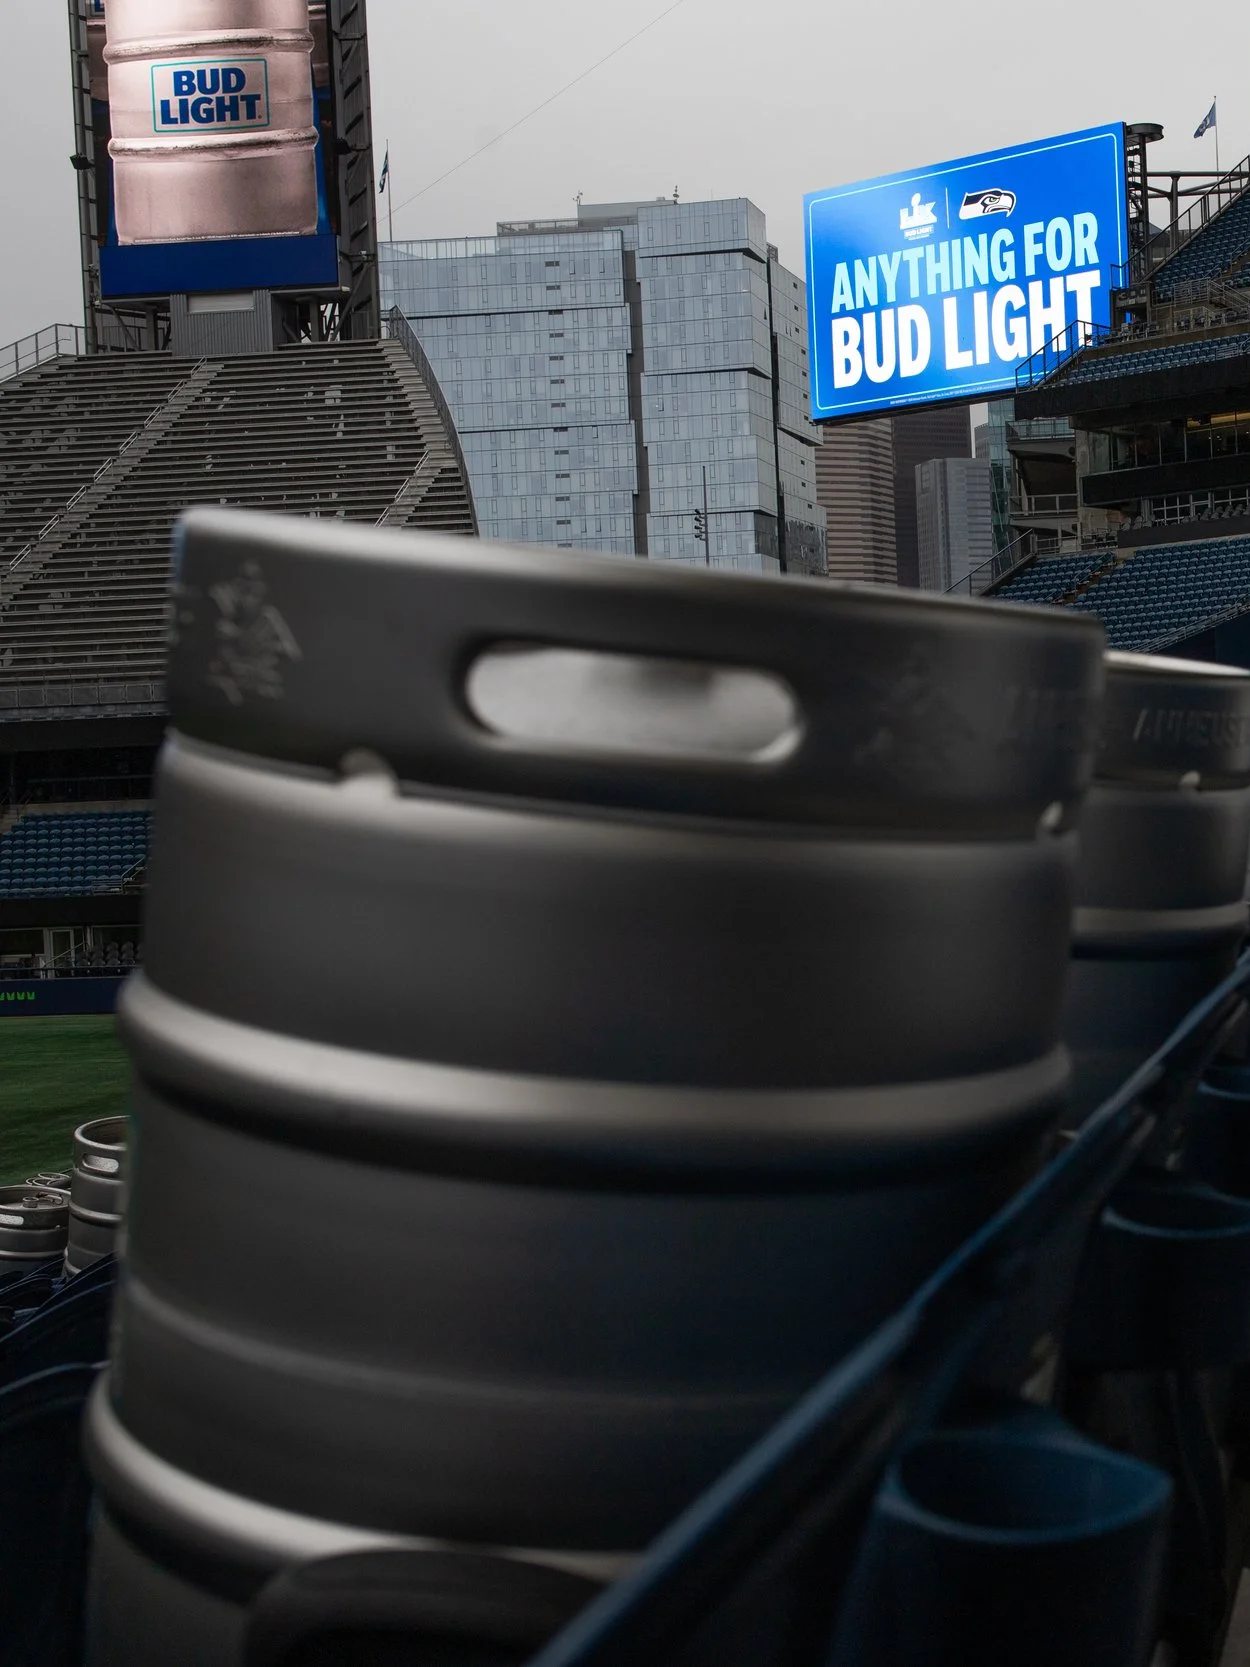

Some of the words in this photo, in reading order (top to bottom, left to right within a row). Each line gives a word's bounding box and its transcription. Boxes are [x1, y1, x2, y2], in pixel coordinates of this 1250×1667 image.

[160, 94, 261, 125] LIGHT
[173, 67, 246, 97] BUD
[831, 228, 1016, 314] ANYTHING
[1023, 212, 1100, 277] FOR
[831, 304, 932, 389] BUD
[943, 270, 1101, 371] LIGHT
